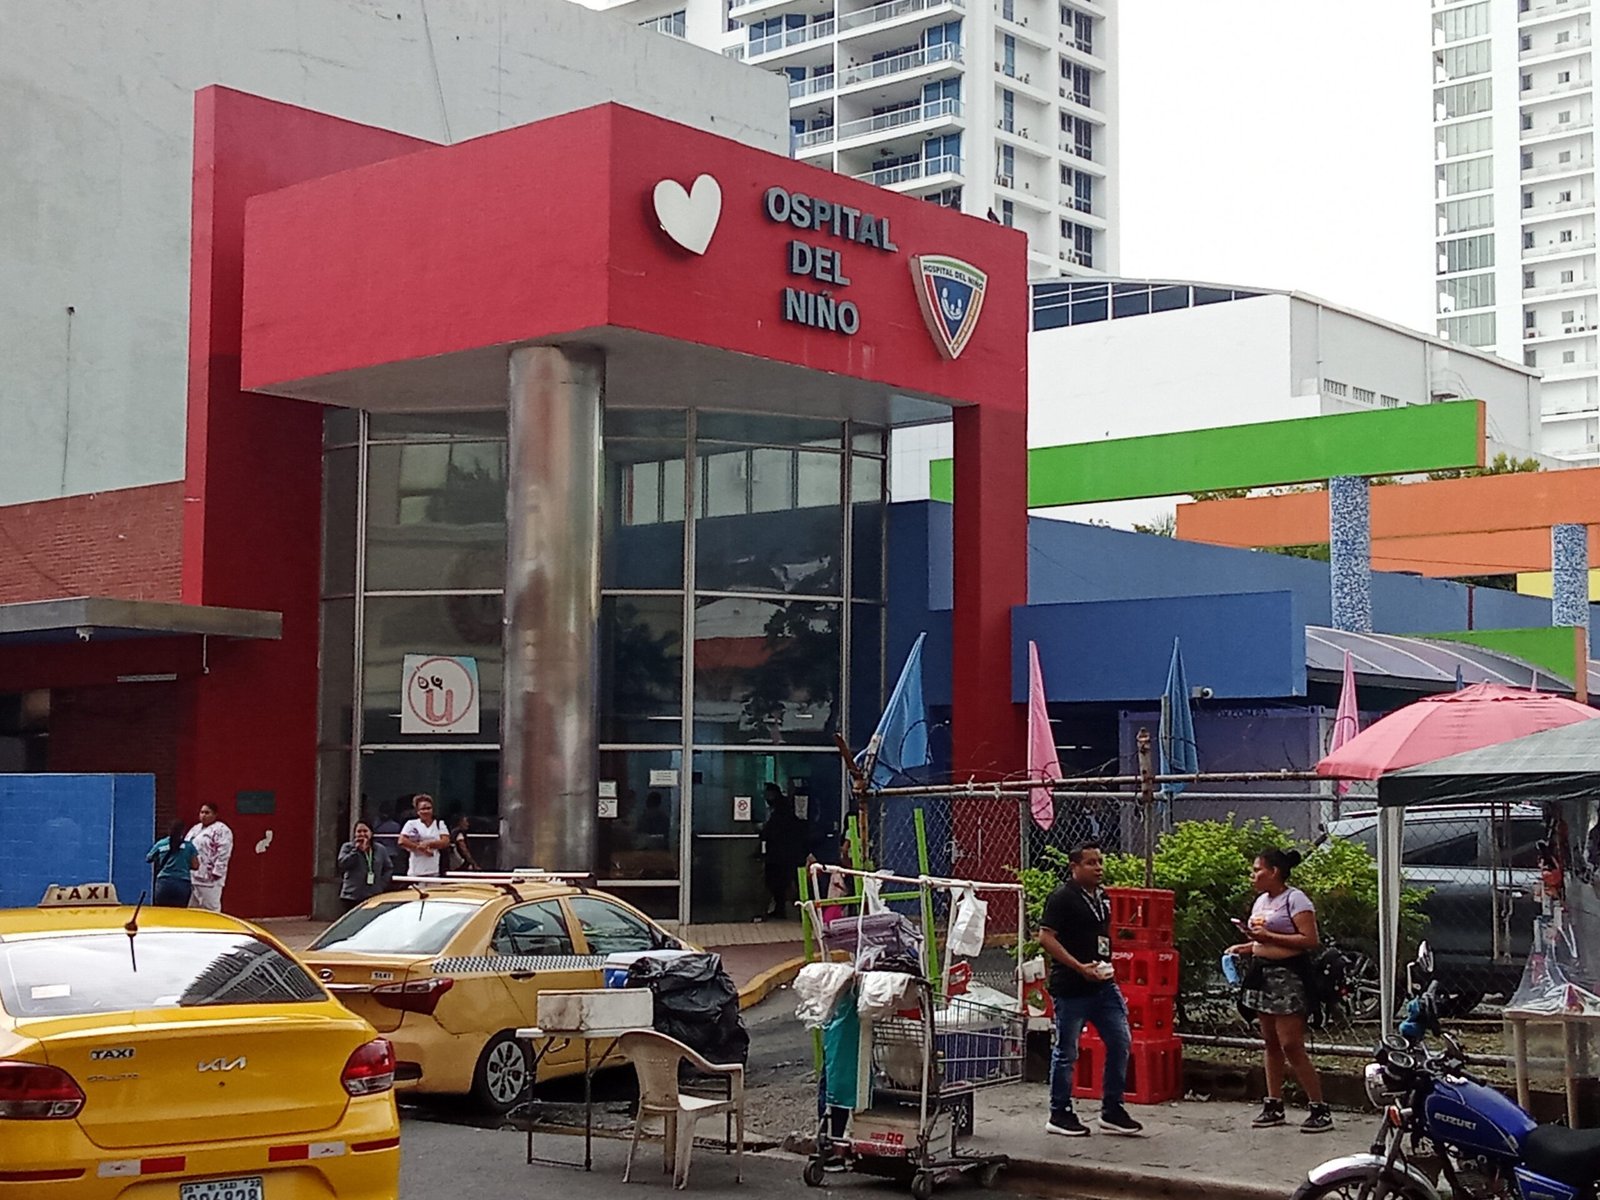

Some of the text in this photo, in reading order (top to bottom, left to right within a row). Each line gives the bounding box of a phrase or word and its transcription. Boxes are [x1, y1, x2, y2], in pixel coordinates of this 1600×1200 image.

[766, 185, 898, 252] OSPITAL
[788, 239, 851, 286] DEL
[923, 264, 953, 278] HOSPITAL
[954, 270, 967, 283] DEL
[56, 886, 109, 901] TAXI
[90, 1048, 135, 1060] TAXI
[198, 1056, 247, 1072] KIA
[1434, 1112, 1477, 1131] SUZUKI
